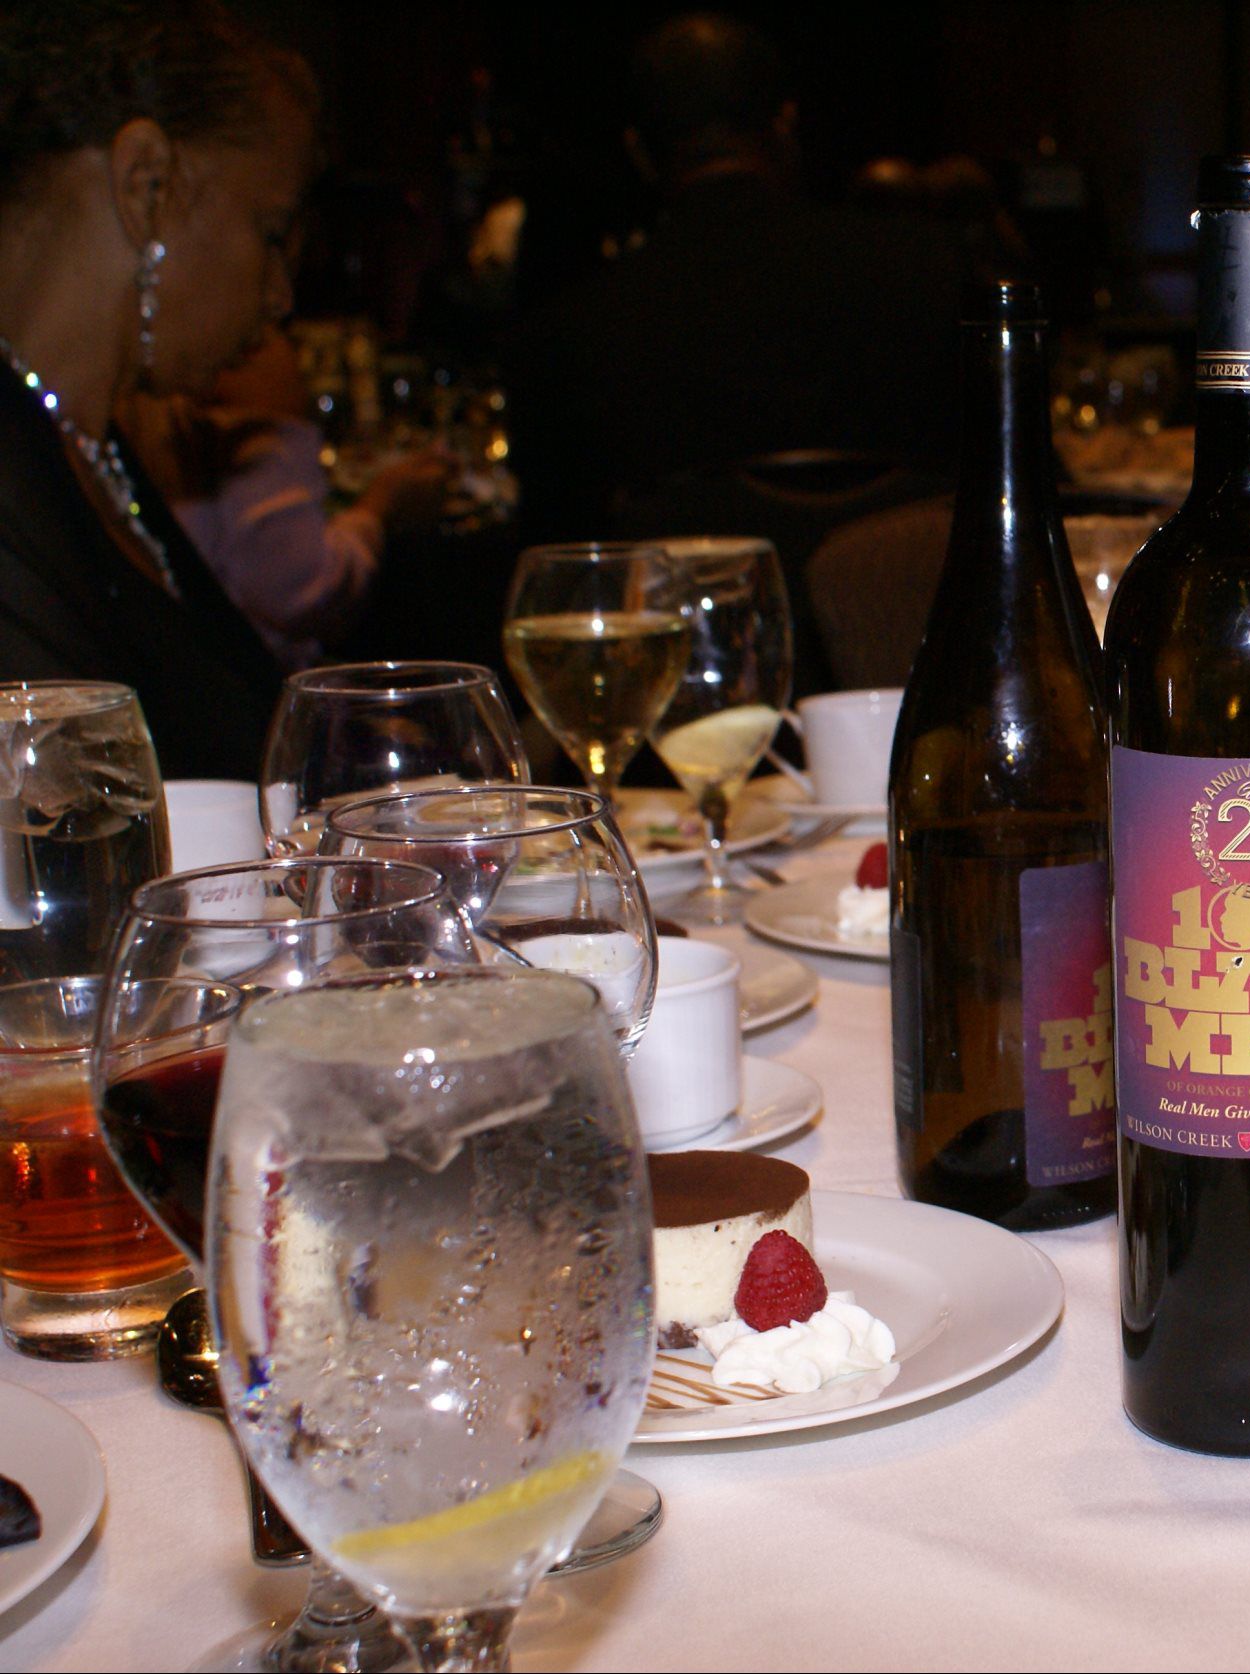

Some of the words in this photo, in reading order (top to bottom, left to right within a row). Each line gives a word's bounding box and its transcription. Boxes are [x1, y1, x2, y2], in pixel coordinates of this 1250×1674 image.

[1209, 363, 1250, 377] CREEK
[1166, 1080, 1185, 1092] OF
[1186, 1082, 1246, 1097] ORANGE
[1159, 1098, 1186, 1115] Real
[1189, 1101, 1220, 1119] Men
[1126, 1114, 1172, 1141] WILSON
[1177, 1129, 1233, 1148] CREEK
